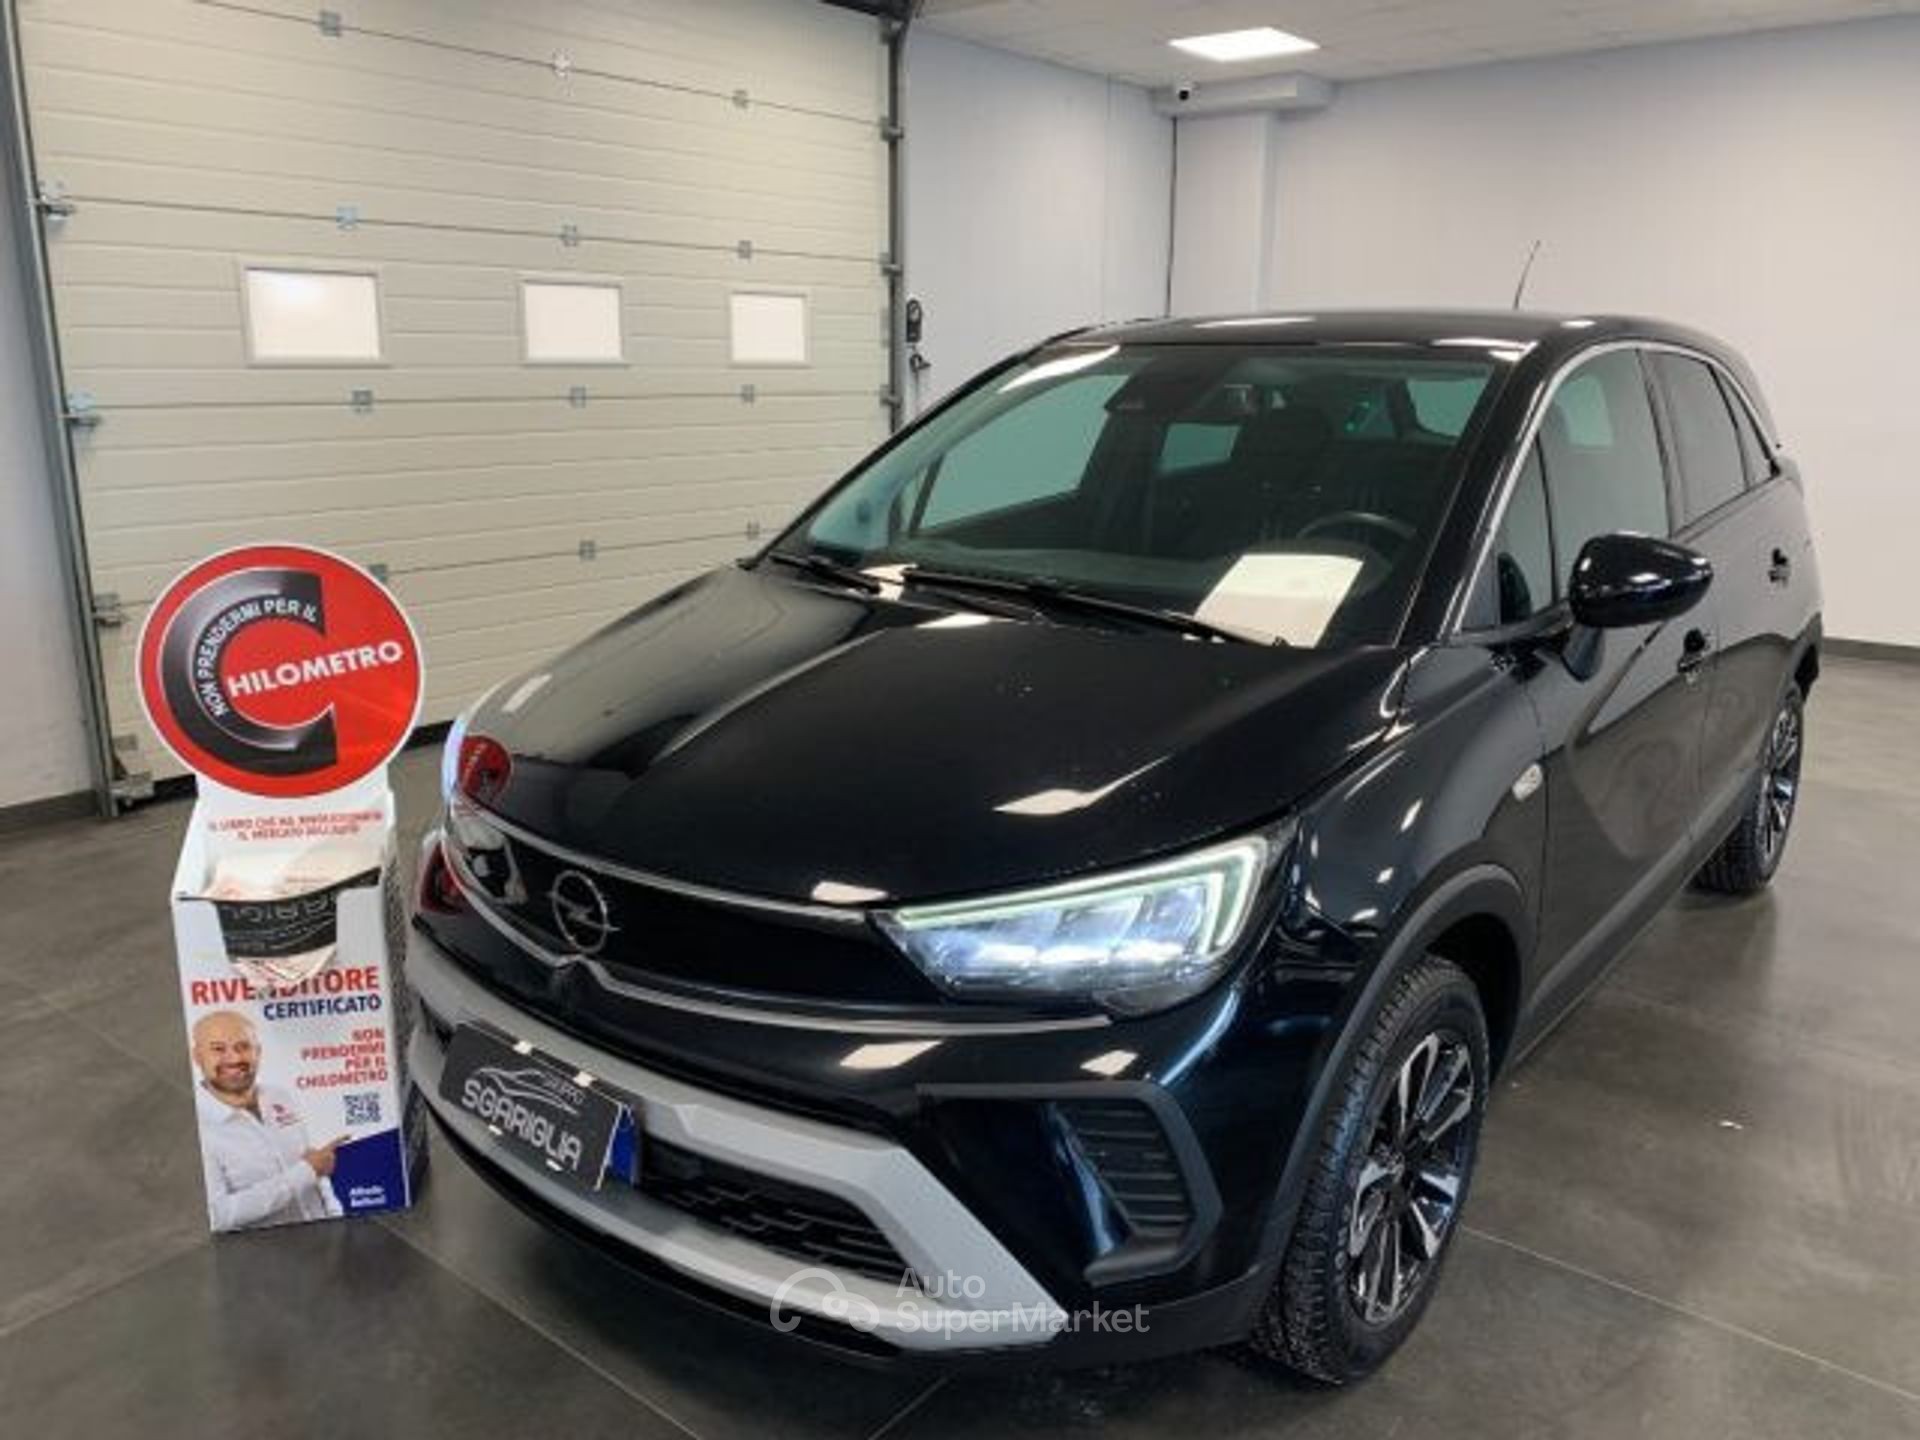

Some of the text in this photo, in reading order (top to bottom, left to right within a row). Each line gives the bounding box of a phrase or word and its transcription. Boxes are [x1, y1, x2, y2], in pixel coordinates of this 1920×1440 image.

[264, 599, 301, 615] PER
[197, 600, 262, 679] PRENDERMI
[226, 641, 403, 698] HILOMETRO
[198, 682, 230, 717] NON
[263, 994, 382, 1021] CERTIFICATO
[352, 1027, 385, 1041] NON
[345, 1057, 371, 1071] PER
[461, 1078, 583, 1171] SGARIGLIA
